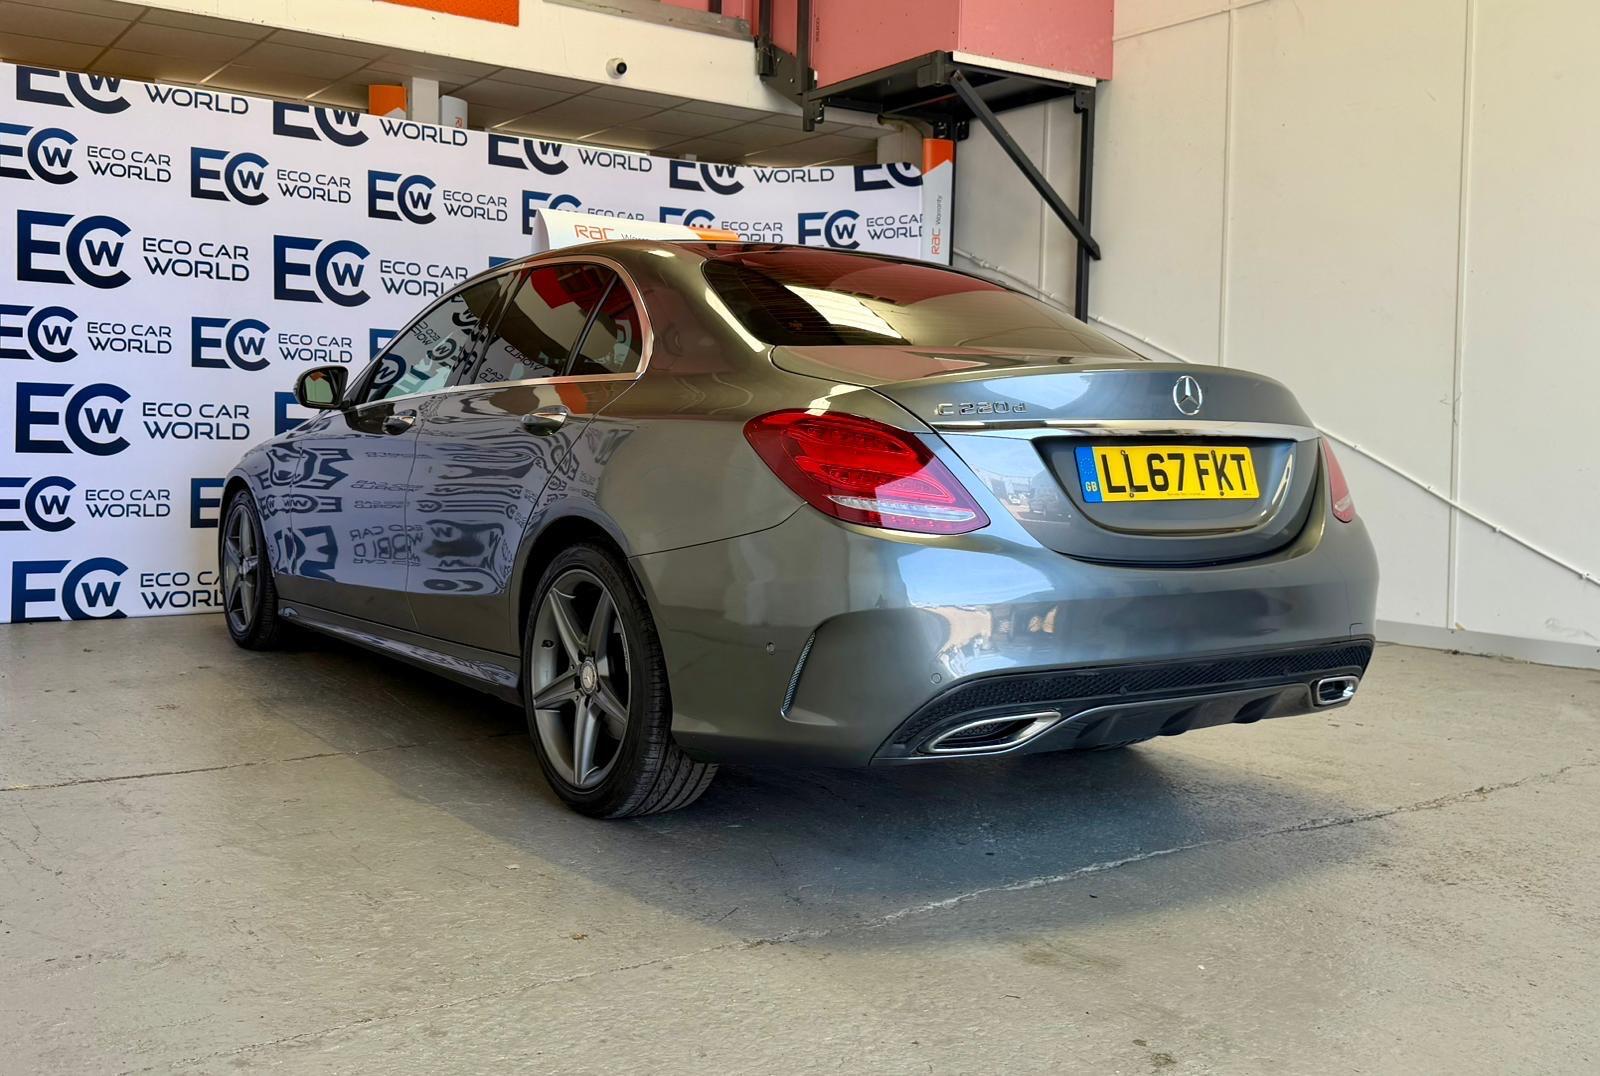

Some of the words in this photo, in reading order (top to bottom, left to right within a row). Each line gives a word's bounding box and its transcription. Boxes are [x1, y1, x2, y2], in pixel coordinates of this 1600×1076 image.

[144, 84, 249, 115] WORLD
[379, 118, 468, 146] WORLD
[87, 146, 125, 161] ECO
[131, 151, 170, 166] CAR
[577, 149, 653, 172] WORLD
[88, 161, 171, 182] WORLD
[277, 169, 311, 183] ECO
[316, 174, 350, 188] CAR
[753, 169, 835, 183] WORLD
[278, 183, 351, 204] WORLD
[443, 190, 473, 202] ECO
[477, 194, 507, 207] CAR
[444, 203, 507, 222] WORLD
[867, 217, 895, 227] ECO
[721, 221, 749, 231] ECO
[753, 222, 782, 231] CAR
[737, 233, 784, 243] ORLD
[143, 237, 192, 255] ECO
[199, 243, 249, 260] CAR
[144, 256, 249, 282] WORLD
[380, 260, 421, 276] ECO
[427, 265, 468, 280] CAR
[381, 277, 444, 297] WORL
[87, 322, 126, 335] ECO
[131, 325, 171, 337] CAR
[88, 336, 172, 354] WORLD
[278, 333, 312, 346] ECO
[317, 336, 352, 348] CAR
[279, 347, 352, 363] WORLD
[143, 402, 192, 417] ECO
[199, 404, 250, 419] CAR
[143, 421, 250, 440] WORLD
[1101, 453, 1186, 493] LL67
[1194, 453, 1248, 492] FKT
[85, 489, 124, 501] ECO
[130, 489, 170, 500] CAR
[1085, 481, 1098, 492] GB
[86, 504, 170, 518] WORLD
[140, 572, 190, 587] ECO
[140, 589, 222, 609] WORL
